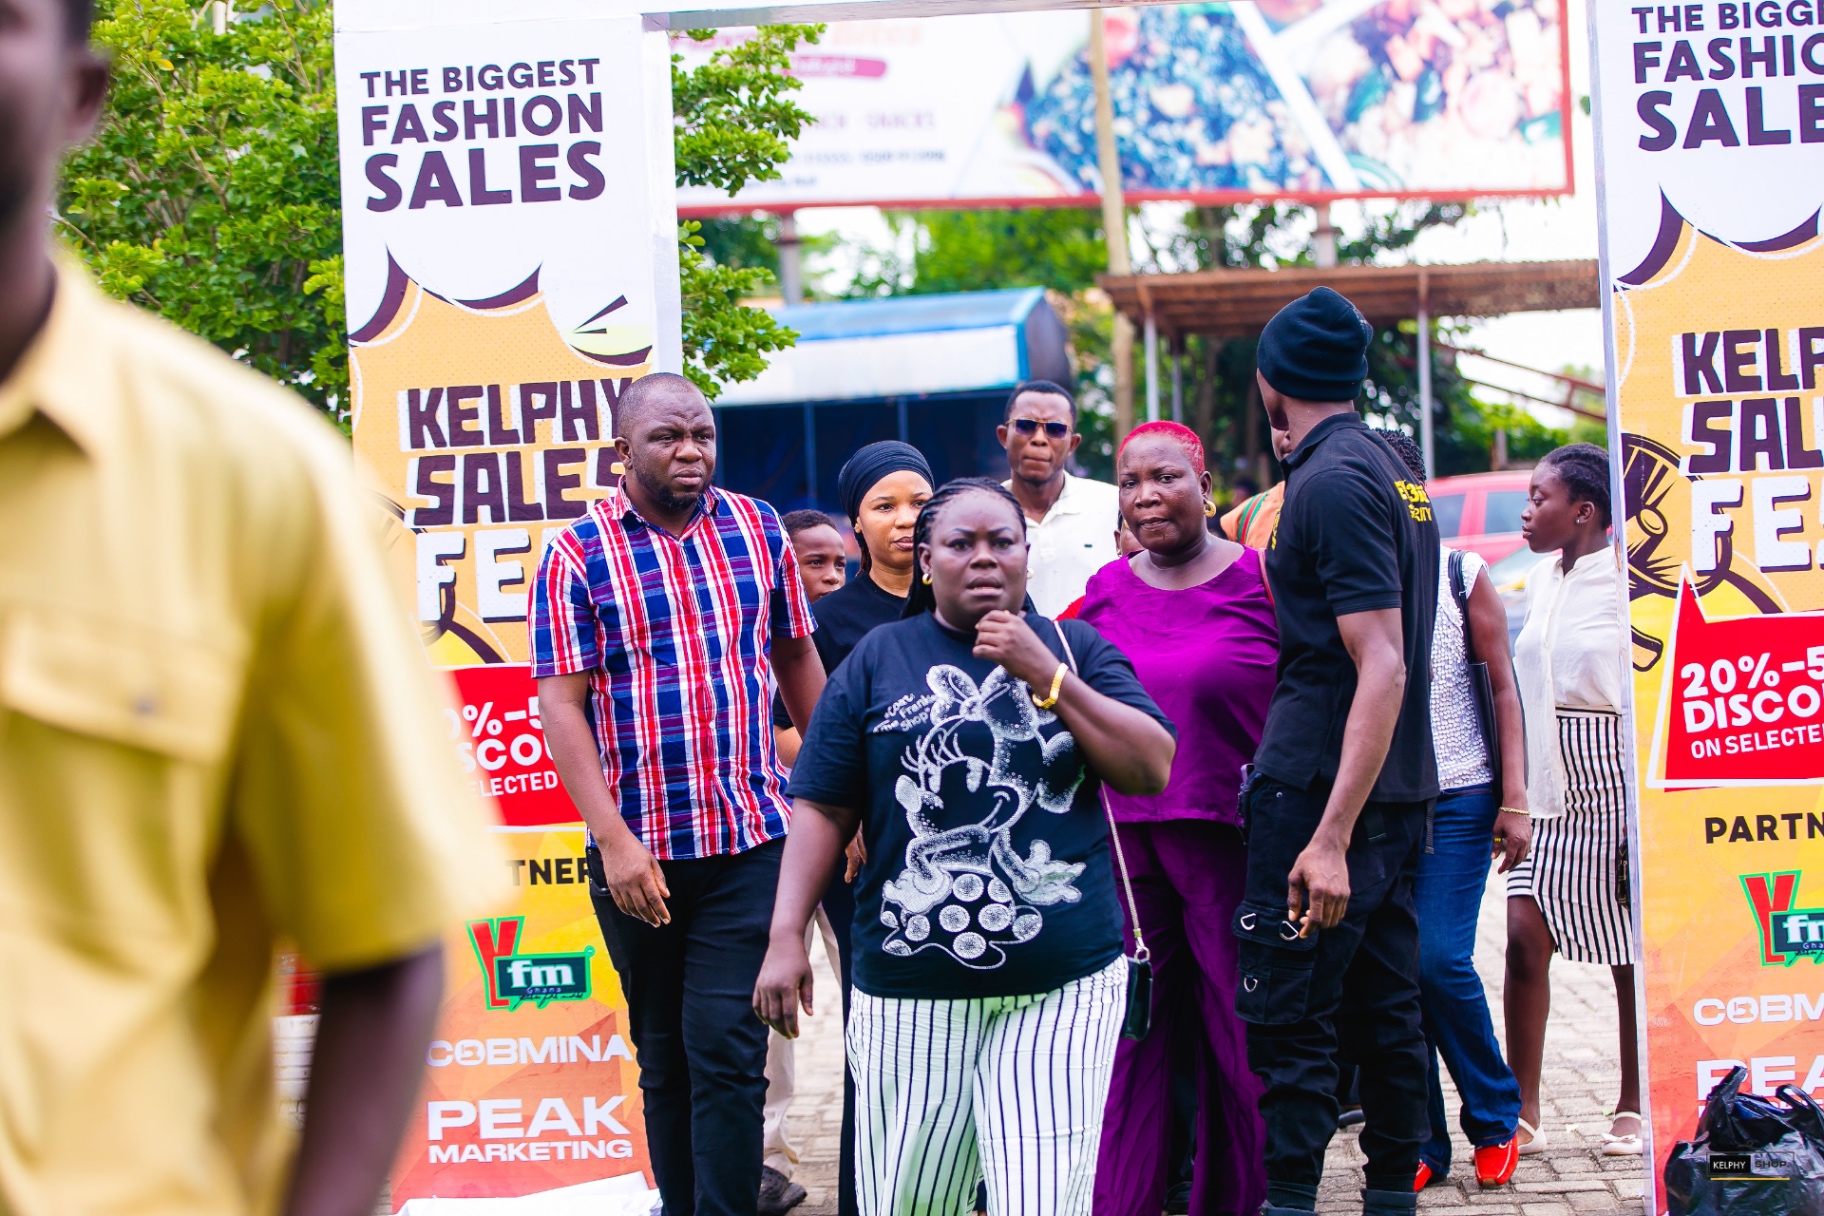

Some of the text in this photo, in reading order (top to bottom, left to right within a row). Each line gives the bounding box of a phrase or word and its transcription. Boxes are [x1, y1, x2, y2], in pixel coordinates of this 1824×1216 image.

[1631, 4, 1704, 34] THE
[360, 58, 600, 98] THE BIGGEST
[1633, 33, 1824, 84] FASHIO
[361, 92, 603, 146] FASHION
[1637, 83, 1824, 152] SALE
[364, 141, 606, 213] SALES
[1680, 326, 1824, 395] KELP
[404, 377, 633, 449] KELPHY
[1686, 396, 1824, 474] SAL
[1691, 475, 1824, 577] FE
[416, 528, 560, 624] FE
[1680, 645, 1824, 699] 20%-5
[1682, 683, 1824, 734] DISCO
[1690, 724, 1824, 759] ON SELECTE
[1705, 812, 1824, 844] PARTN
[506, 960, 576, 988] fm
[425, 1034, 634, 1068] COBMINA
[427, 1095, 632, 1141] PEAK
[428, 1139, 633, 1164] MARKETING
